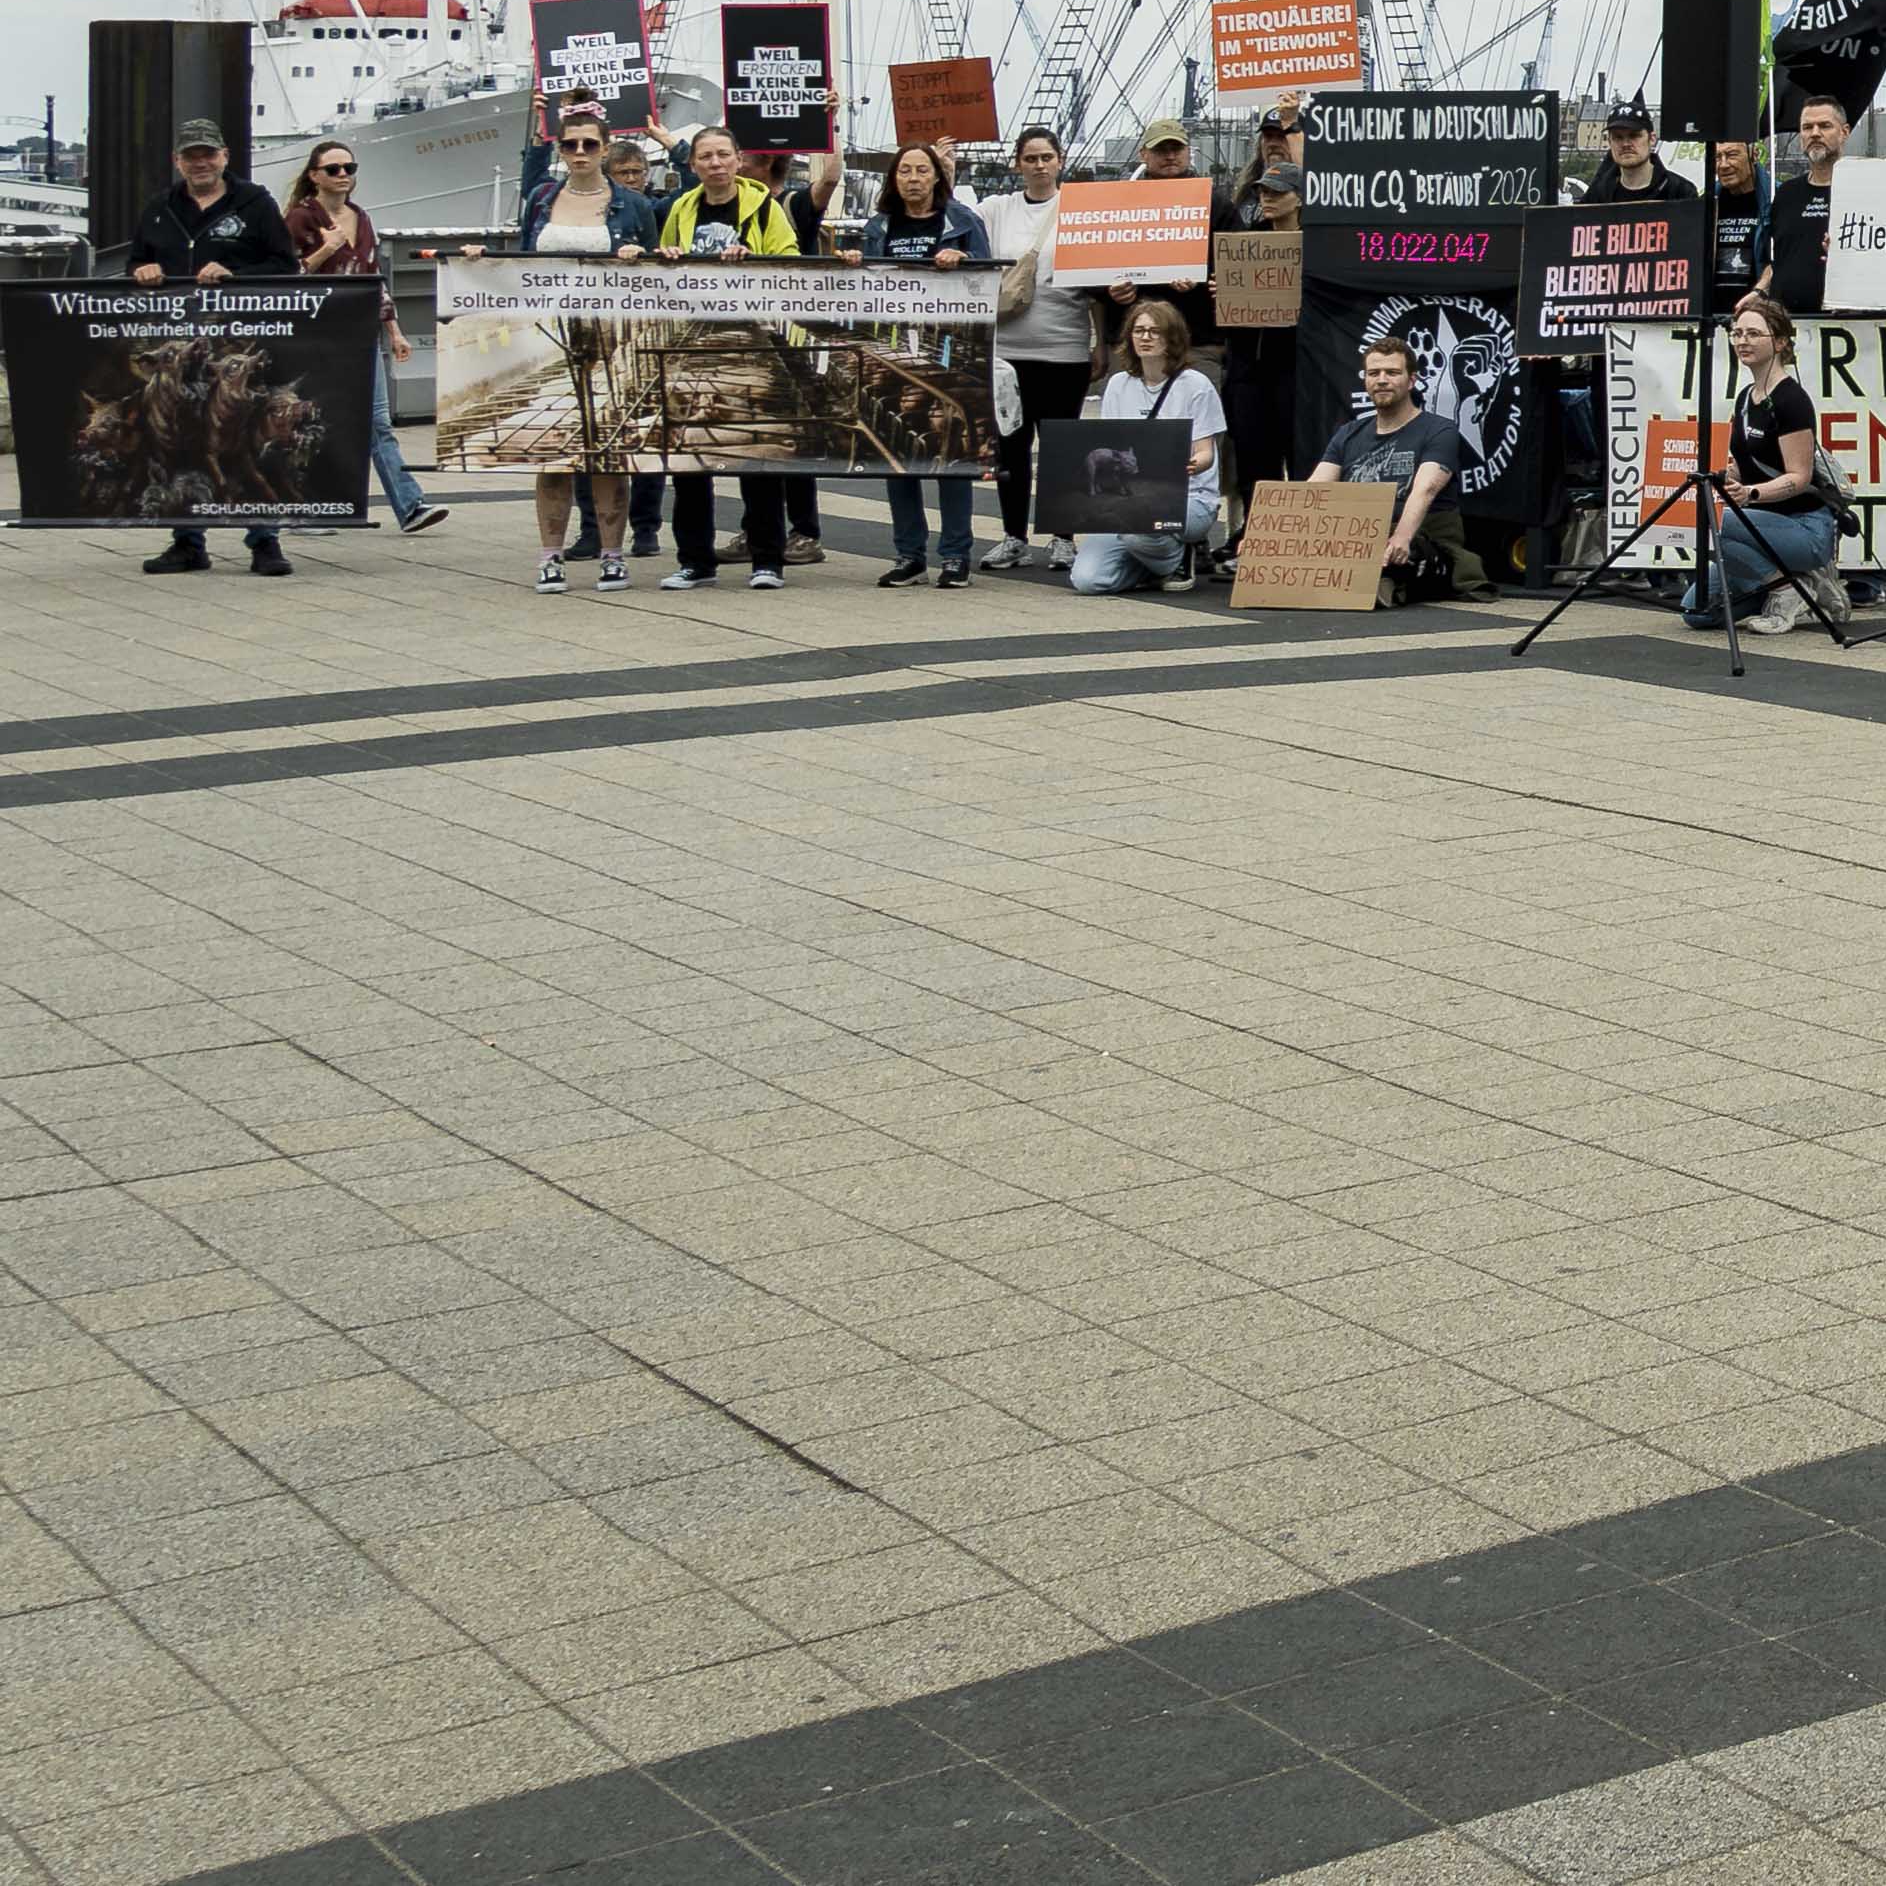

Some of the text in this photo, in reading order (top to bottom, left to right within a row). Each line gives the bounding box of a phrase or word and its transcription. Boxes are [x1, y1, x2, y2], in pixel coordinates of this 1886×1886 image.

[1216, 4, 1352, 33] TIERQUÄLEREI
[572, 36, 611, 48] WEIL
[1219, 39, 1242, 57] IM
[556, 46, 636, 64] ERSTICKEN
[759, 49, 795, 61] WEIL
[572, 60, 618, 74] KEINE
[742, 63, 818, 75] ERSTICKEN
[1222, 53, 1355, 79] SCHLACHTHAUS!
[546, 71, 646, 90] BETÄUBUNG
[756, 77, 799, 88] KEINE
[731, 90, 825, 102] BETÄUBUNG
[767, 104, 794, 115] IST!
[1308, 105, 1547, 144] SCHWEINE IN DEUTSCHLAND
[1306, 170, 1364, 207] DURCH
[1488, 167, 1541, 205] 2026
[1060, 204, 1209, 226] WEGSCHAUEN TÖTET.
[1057, 226, 1208, 246] MACH DICH SCHLAU.
[1572, 221, 1669, 257] DIE BILDER
[1719, 235, 1746, 243] LEBEN
[1356, 232, 1490, 263] 18.022.047
[521, 272, 926, 294] Statt zu klagen, dass wir nicht alles haben,
[1254, 267, 1295, 288] KEIN
[1545, 259, 1688, 298] BLEIBEN AN DER
[51, 291, 186, 319] Witnessing
[453, 292, 993, 314] sollten wir daran denken, was wir anderen alles nehmen.
[89, 321, 294, 338] Die Wahrheit vor Gericht
[1663, 439, 1695, 454] SCHWER
[191, 502, 354, 515] #SCHLACHTHOFPROZESS
[1254, 488, 1330, 511] NICHT DIE
[1248, 514, 1381, 539] KAMERA IST DAS
[1238, 565, 1353, 592] DAS SYSTEM!
